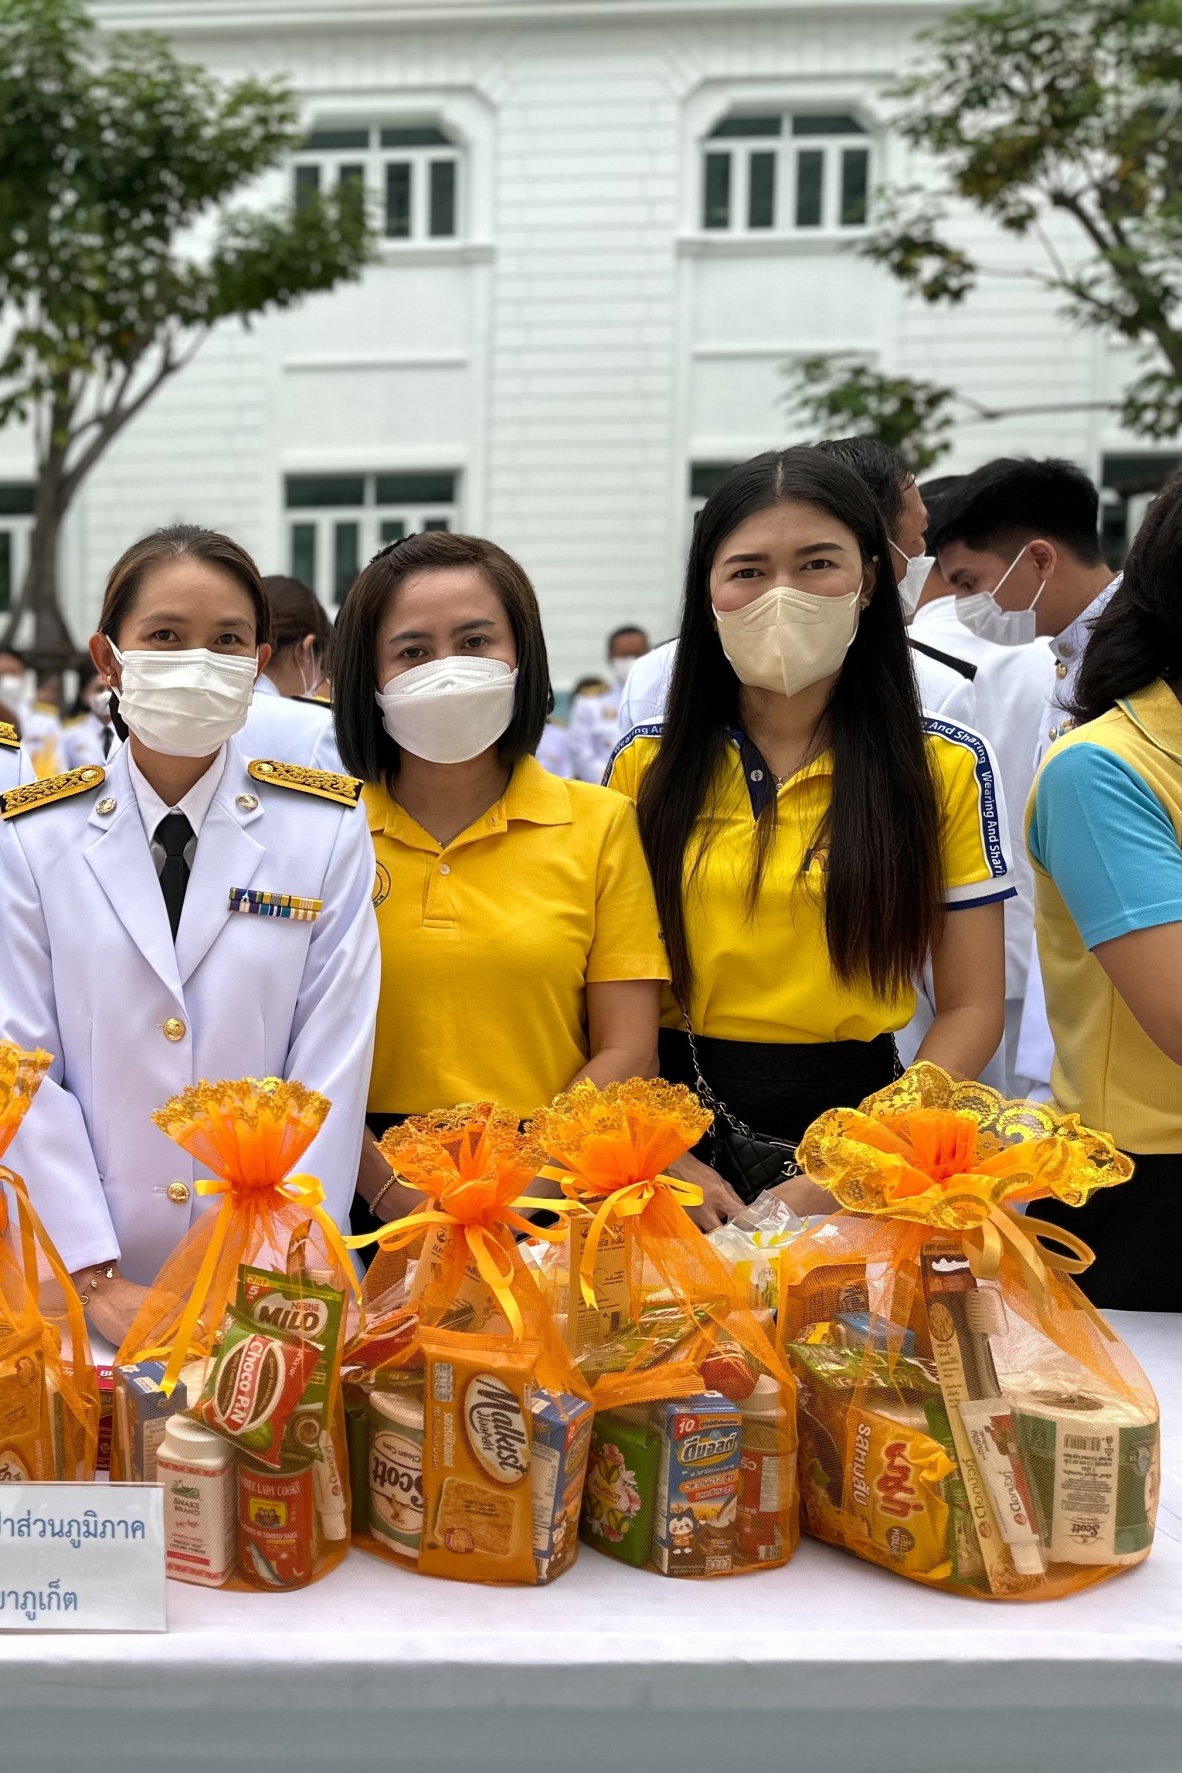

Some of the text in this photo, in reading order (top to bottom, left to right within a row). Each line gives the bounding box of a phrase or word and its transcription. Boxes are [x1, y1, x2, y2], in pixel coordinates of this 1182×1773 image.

[614, 727, 648, 754] Wearing
[929, 721, 1006, 877] And Sharing Wearing And Shari
[259, 1305, 319, 1331] MILO
[239, 1341, 264, 1391] Choco
[469, 1377, 527, 1475] Malkist
[678, 1419, 695, 1434] 10
[399, 1450, 421, 1462] Clean
[851, 1423, 871, 1506] รสหมูสับ
[372, 1456, 422, 1508] Scott
[876, 1442, 925, 1518] มาม่า
[173, 1498, 199, 1509] SNAKE
[174, 1505, 200, 1516] BRAND
